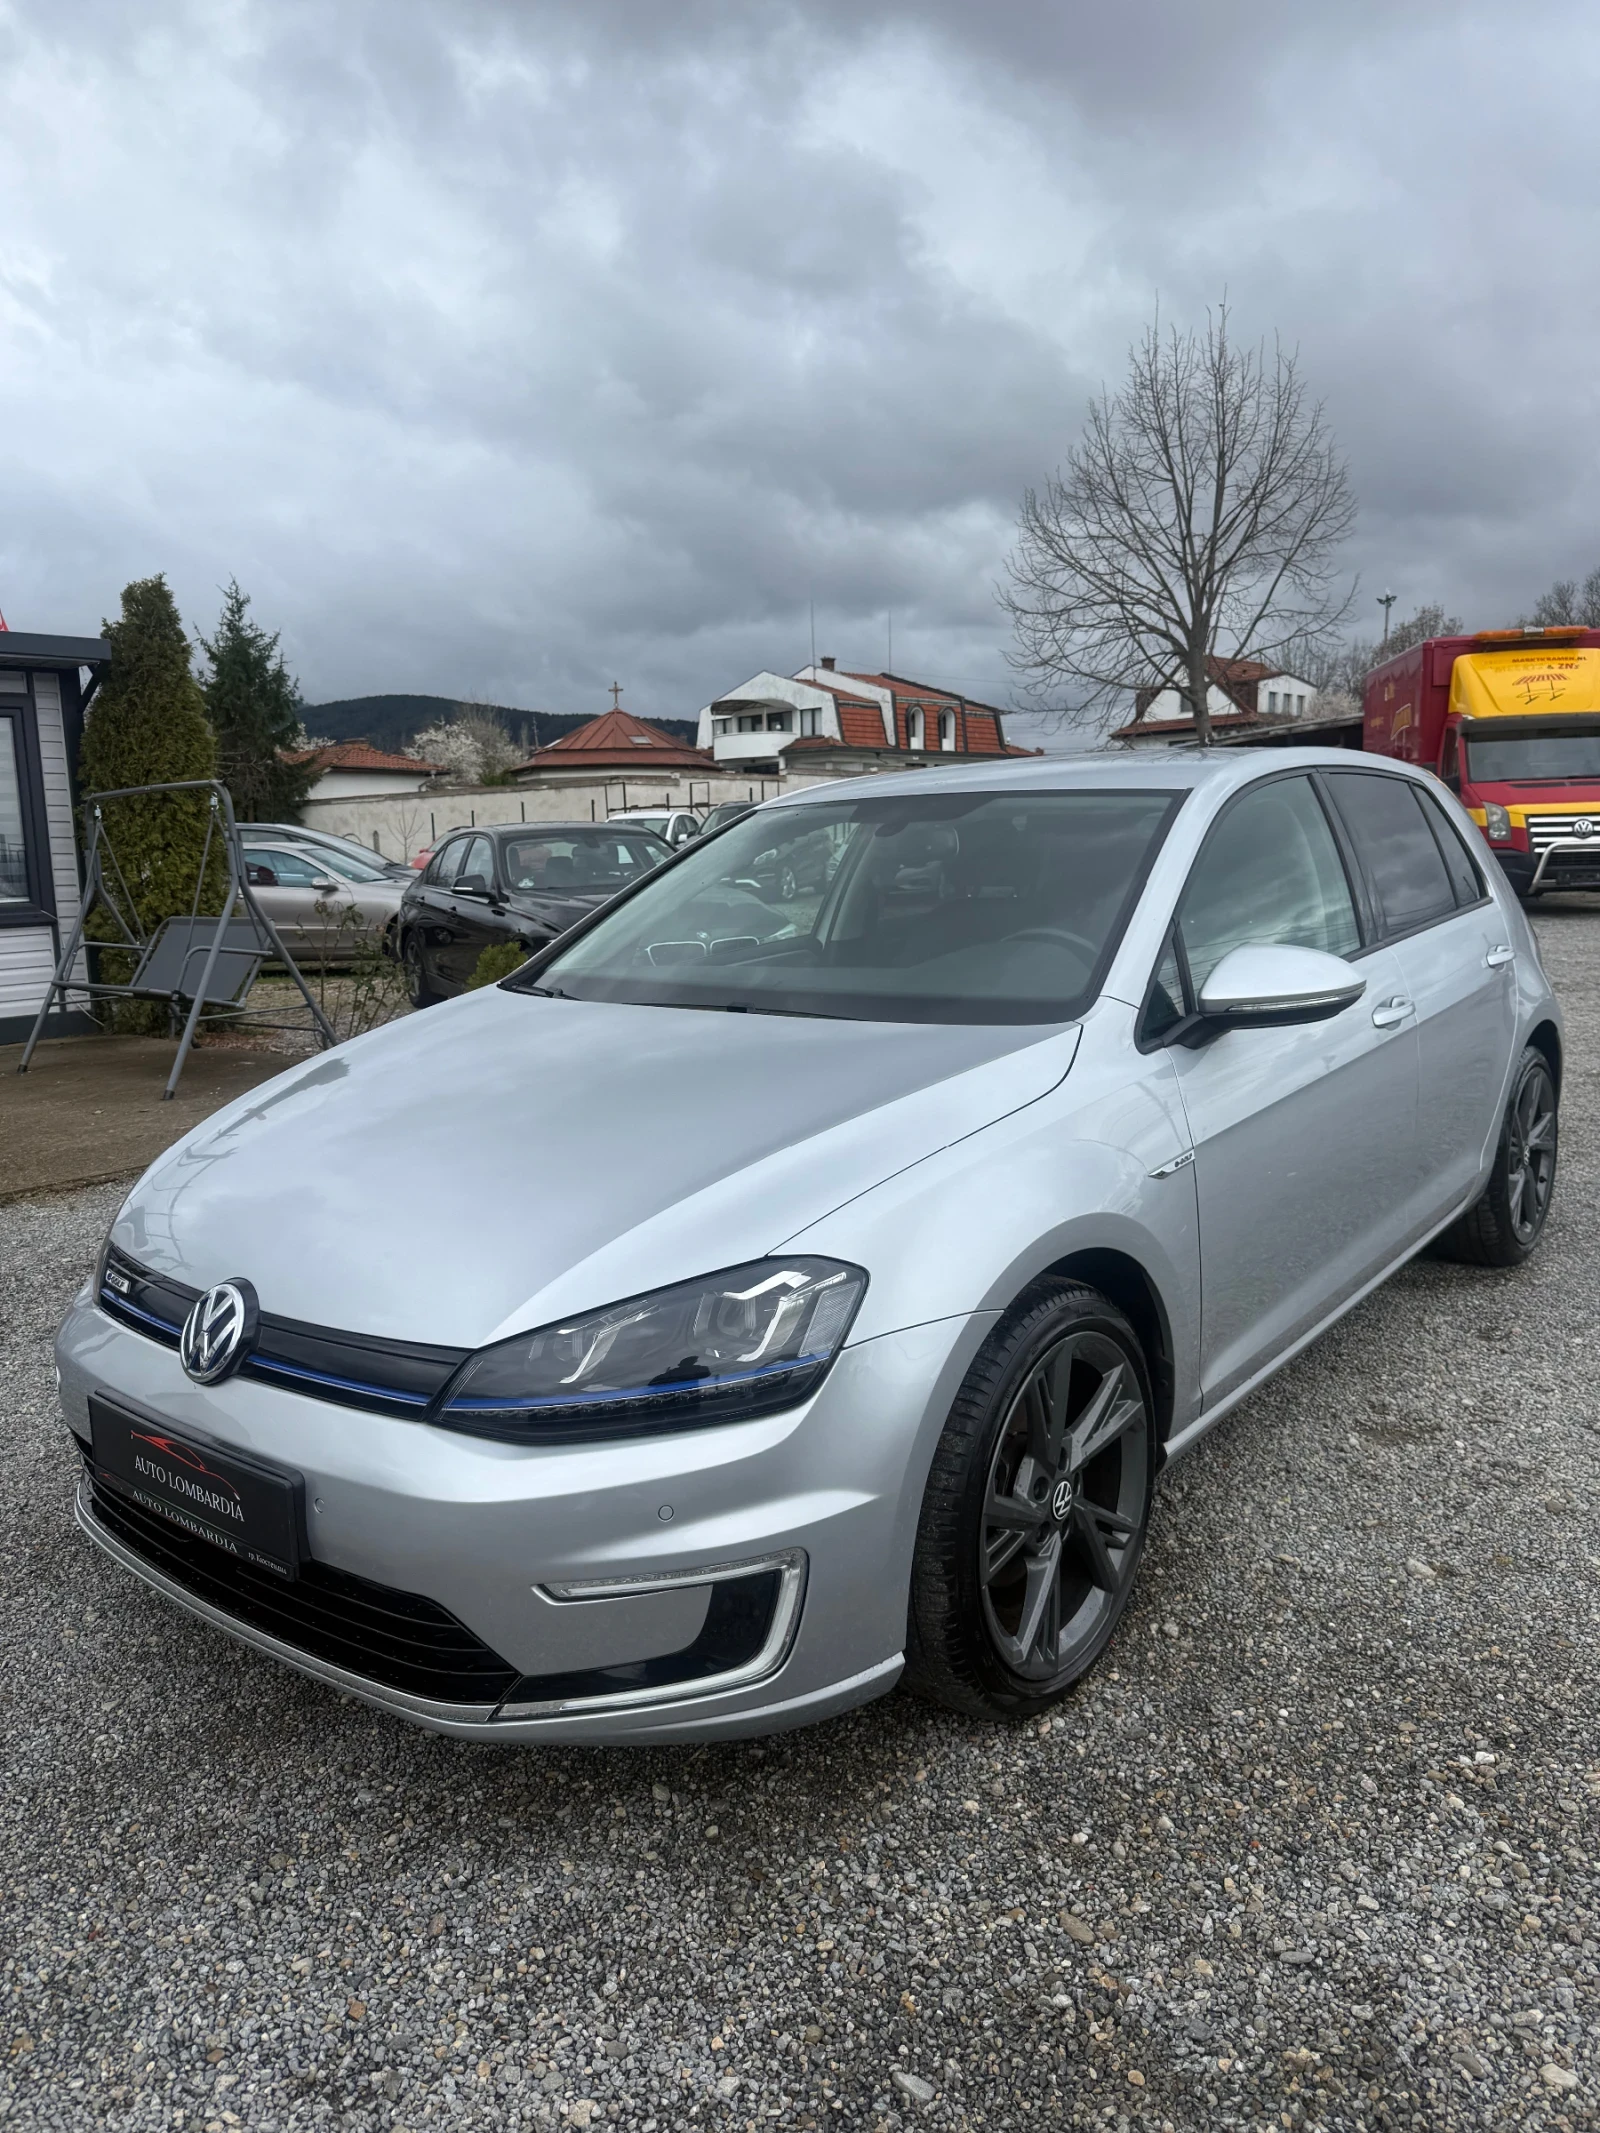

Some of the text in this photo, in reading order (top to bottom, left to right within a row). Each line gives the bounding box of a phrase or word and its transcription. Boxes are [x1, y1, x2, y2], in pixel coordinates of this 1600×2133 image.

[132, 1489, 238, 1554] AUTO LOMBARDIA
[134, 1454, 245, 1523] AUTO LOMBARDIA
